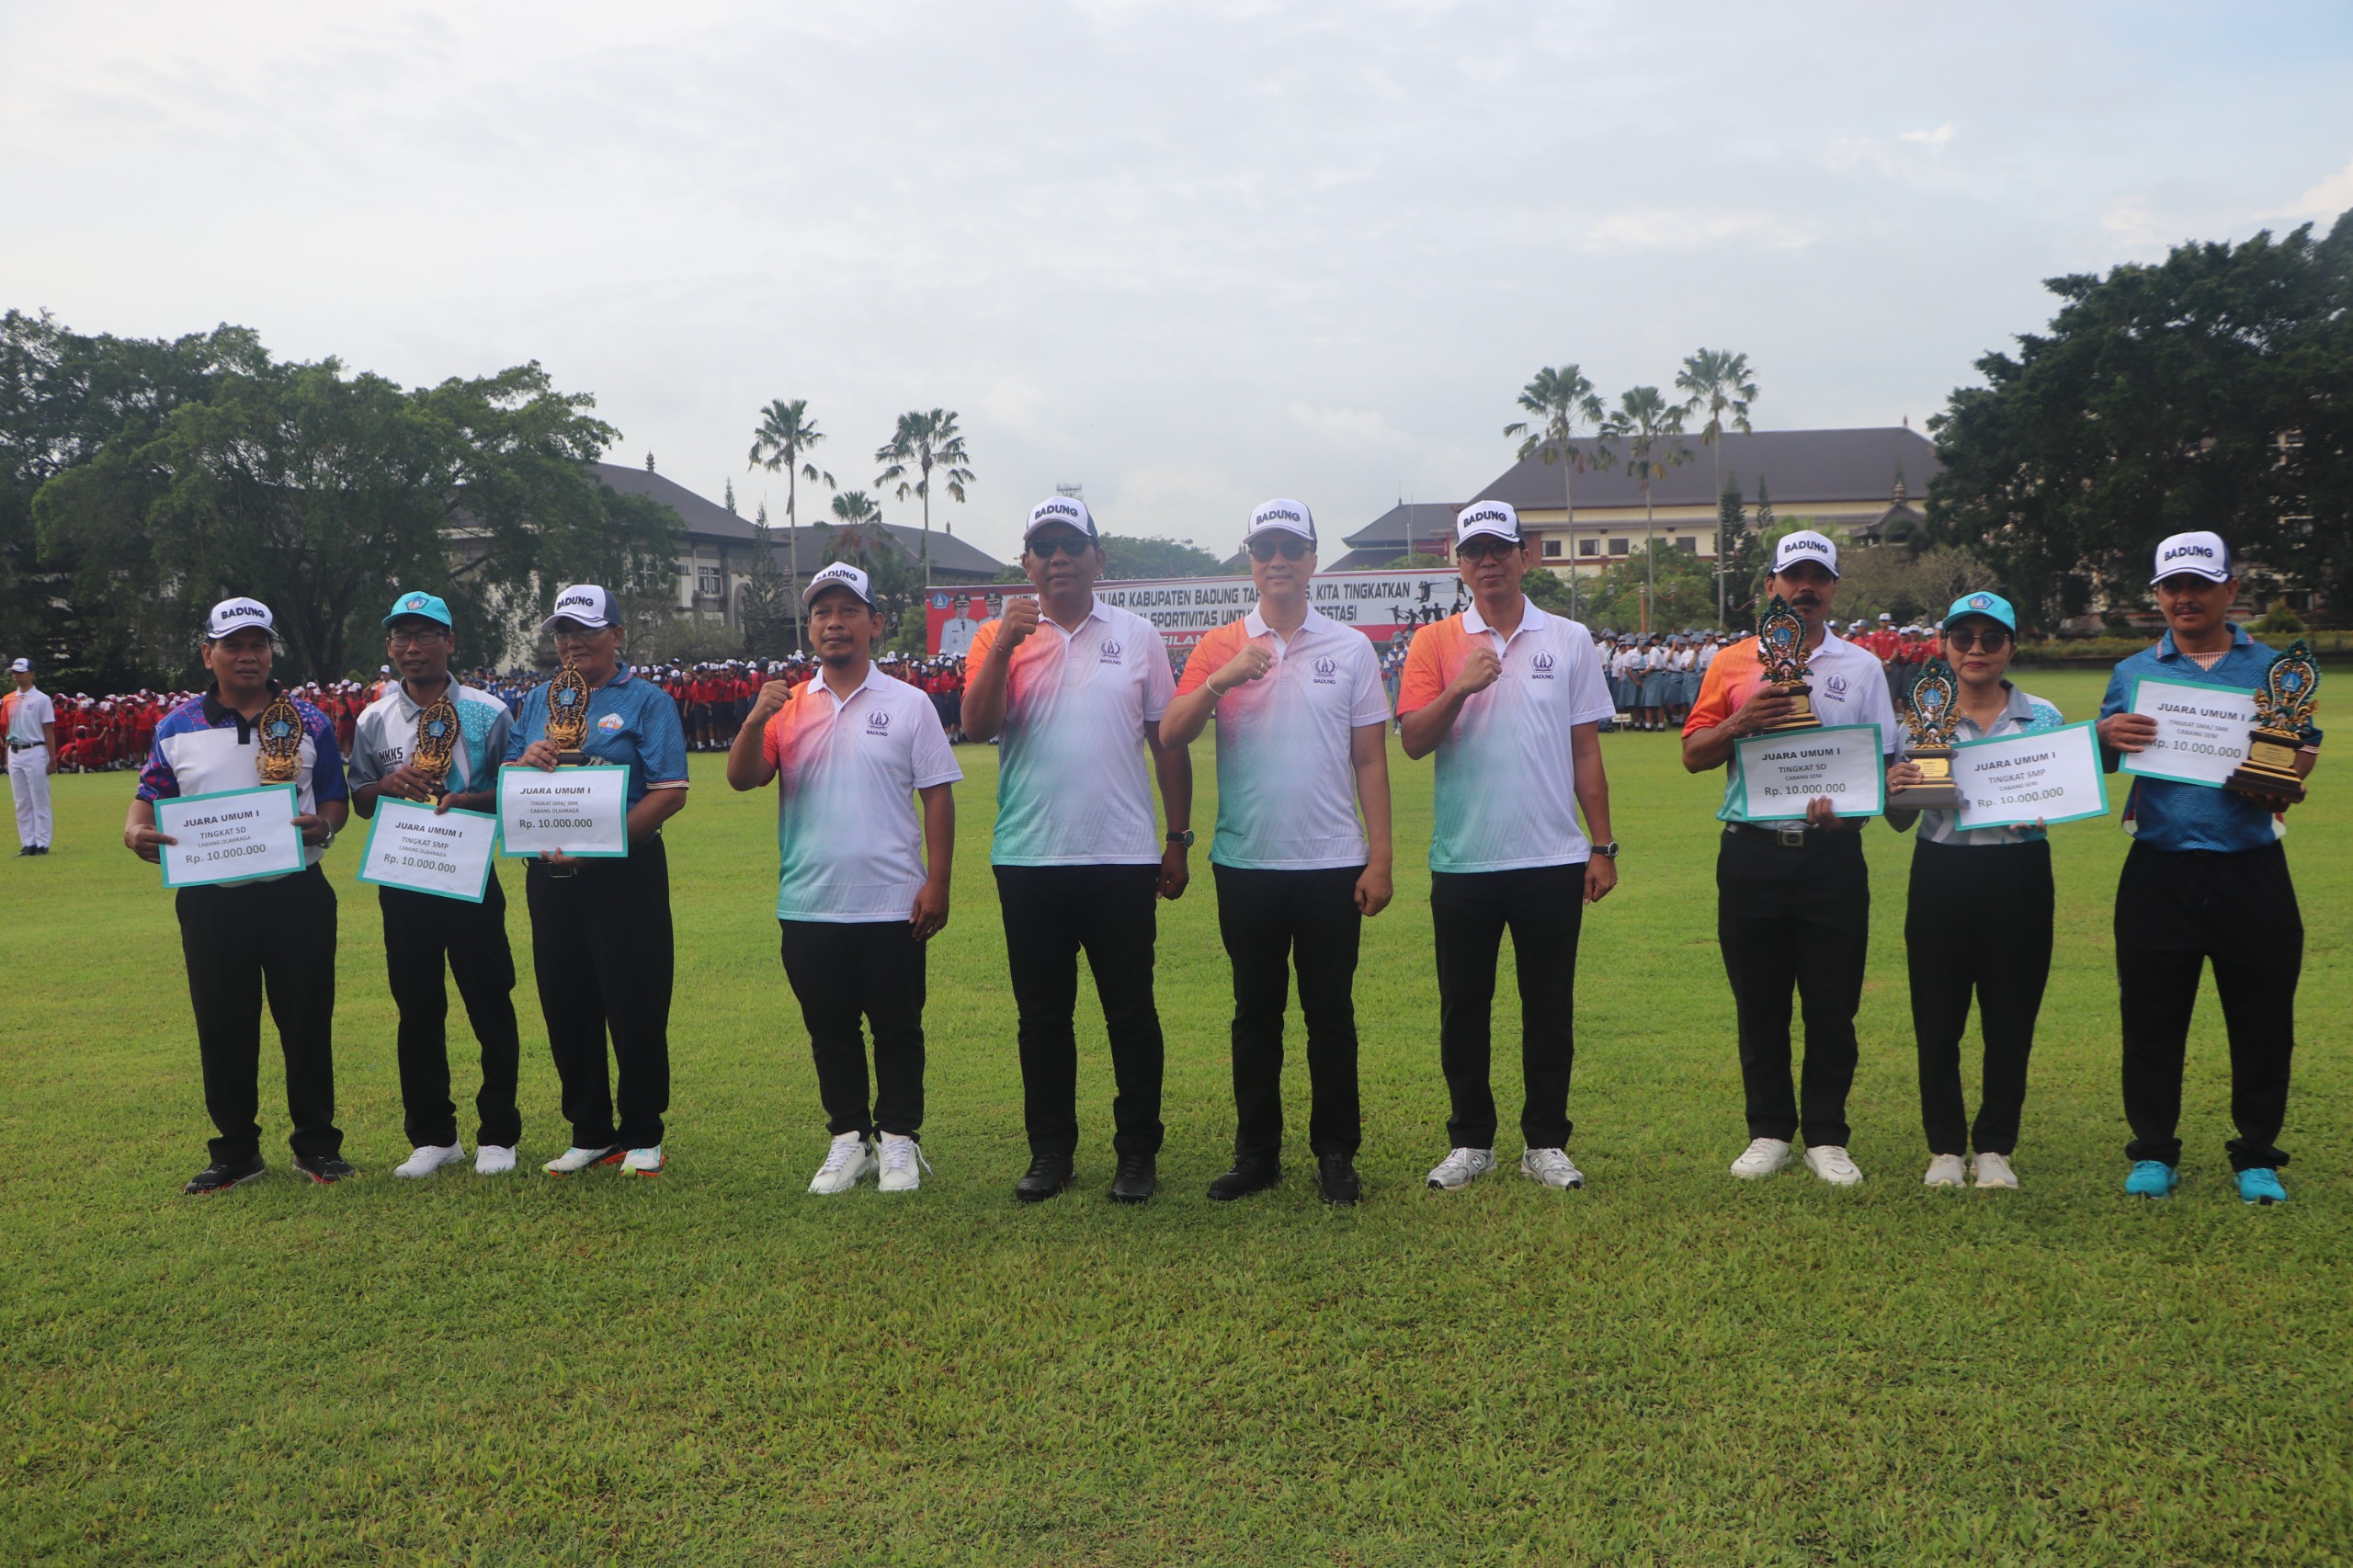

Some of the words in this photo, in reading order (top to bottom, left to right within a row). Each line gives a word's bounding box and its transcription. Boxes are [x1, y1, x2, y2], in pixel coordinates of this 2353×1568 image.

[1034, 504, 1078, 519] BADUNG
[1256, 509, 1301, 525] BADUNG
[1463, 510, 1507, 528] BADUNG
[1784, 540, 1828, 554] BADUNG
[2164, 545, 2213, 562] BADUNG
[1130, 590, 1191, 607] KABUPATEN
[1195, 588, 1238, 605] BADUNG
[1317, 585, 1339, 600] KITA
[1344, 582, 1410, 599] TINGKATKAN
[557, 596, 594, 610] BADUNG
[221, 607, 266, 619] BADUNG
[1151, 610, 1218, 628] SPORTIVITAS
[2157, 703, 2197, 715] JUARA
[2200, 709, 2238, 722] UMUM
[2241, 713, 2245, 722] I
[2168, 719, 2195, 728] TINGKAT
[2177, 728, 2203, 737] CABANG
[378, 747, 404, 763] MKKS
[1761, 751, 1797, 761] JUARA
[1801, 748, 1835, 758] UMUM
[2173, 740, 2241, 758] 10.000.000
[1973, 760, 2011, 772] JUARA
[2014, 753, 2049, 766] UMUM
[2052, 751, 2056, 759] I
[1778, 765, 1813, 774] TINGKAT
[1988, 773, 2025, 784] TINGKAT
[2027, 768, 2046, 778] SMP
[1765, 787, 1782, 797] Rp.
[1786, 783, 1846, 794] 10.000.000
[1999, 783, 2024, 791] CABANG
[1978, 799, 1996, 809] Rp.
[2000, 787, 2063, 804] 10.000.000
[183, 816, 218, 827] JUARA
[221, 811, 253, 822] UMUM
[519, 819, 535, 830] Rp.
[539, 819, 593, 828] 10.000.000
[200, 828, 233, 839] TINGKAT
[235, 826, 246, 835] SD
[395, 822, 425, 833] JUARA
[427, 826, 457, 837] UMUM
[198, 839, 221, 848] CABANG
[221, 835, 251, 845] OLAHRAGA
[402, 836, 431, 846] TINGKAT
[432, 841, 449, 849] SMP
[186, 854, 204, 865] Rp.
[207, 844, 267, 861] 10.000.000
[398, 846, 419, 854] CABANG
[420, 848, 447, 858] OLAHRAGA
[383, 853, 399, 866] Rp.
[402, 856, 457, 874] 10.000.000
